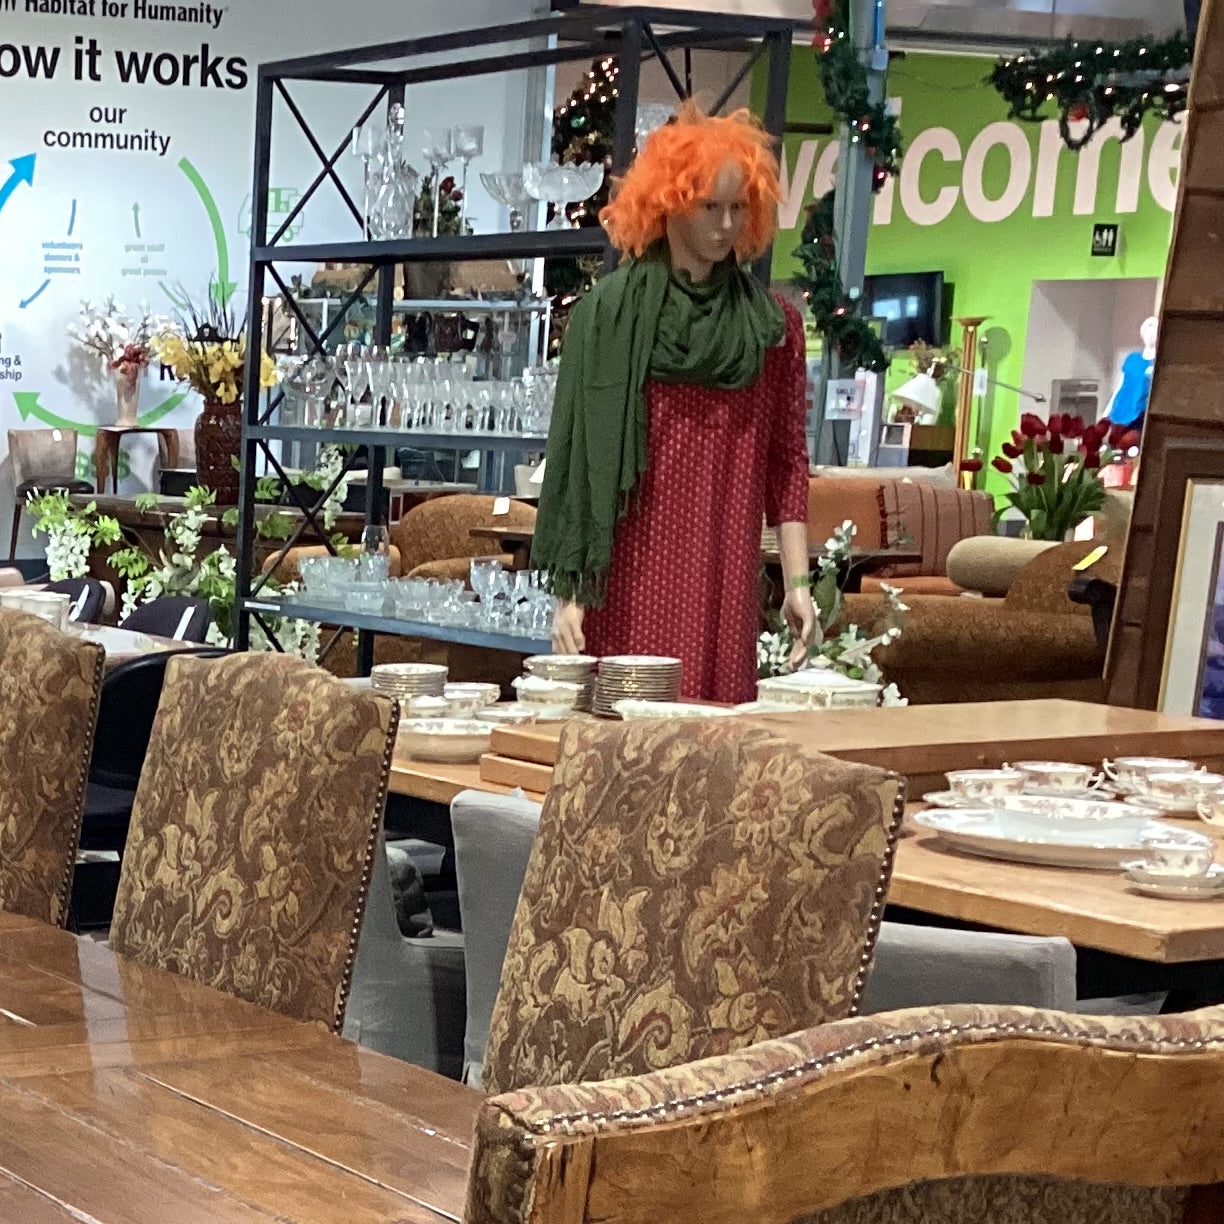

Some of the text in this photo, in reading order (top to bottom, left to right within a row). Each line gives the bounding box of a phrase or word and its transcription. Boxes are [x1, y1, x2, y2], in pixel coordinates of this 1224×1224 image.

[25, 0, 224, 29] Habitat for Humanity
[74, 35, 102, 82] it
[115, 43, 248, 90] works
[89, 106, 128, 124] our
[43, 128, 171, 157] community
